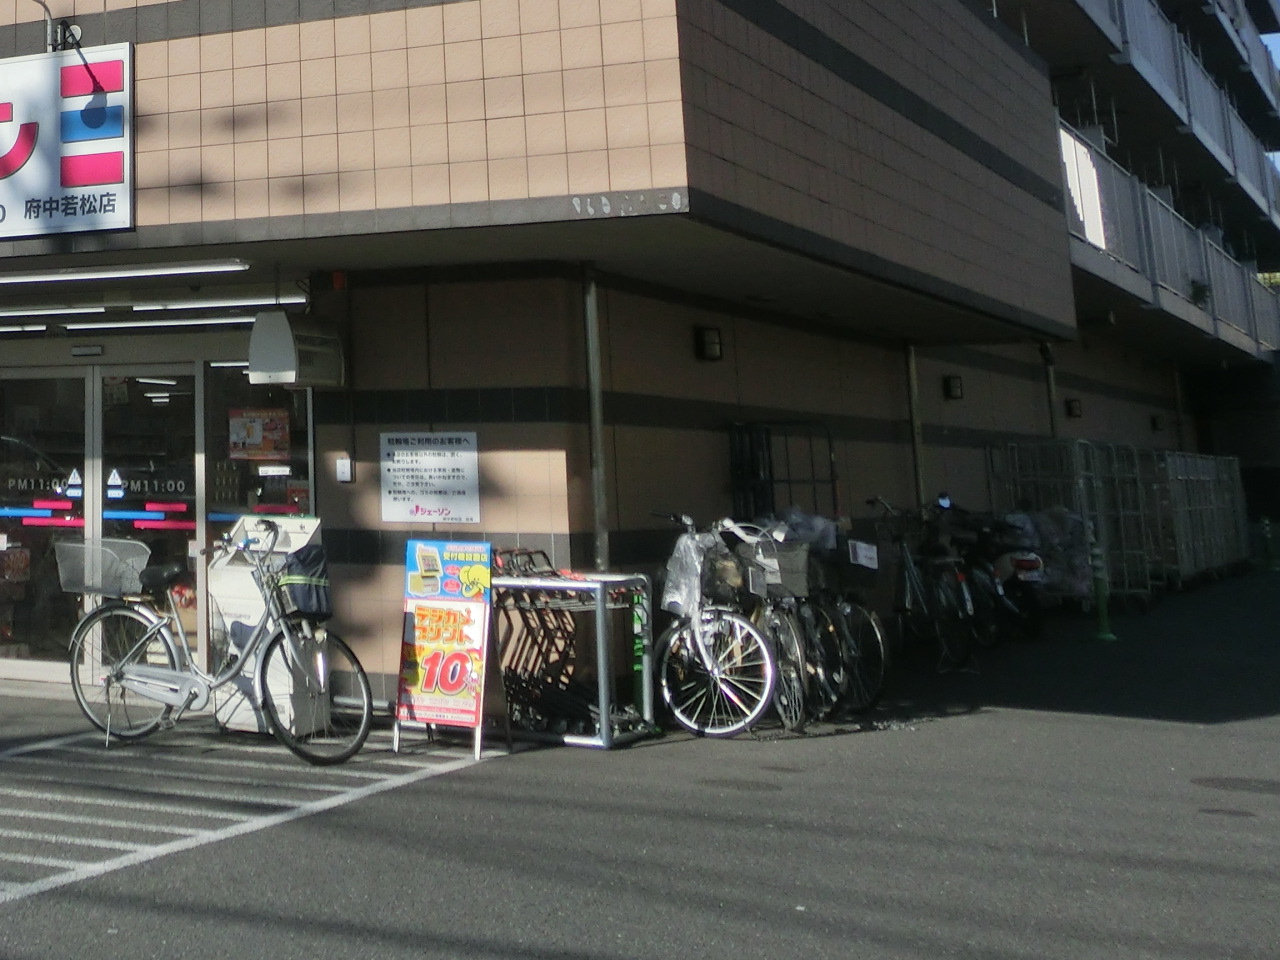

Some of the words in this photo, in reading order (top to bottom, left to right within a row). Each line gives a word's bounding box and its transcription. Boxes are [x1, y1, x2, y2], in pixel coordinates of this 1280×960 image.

[23, 191, 117, 221] 府中若松店
